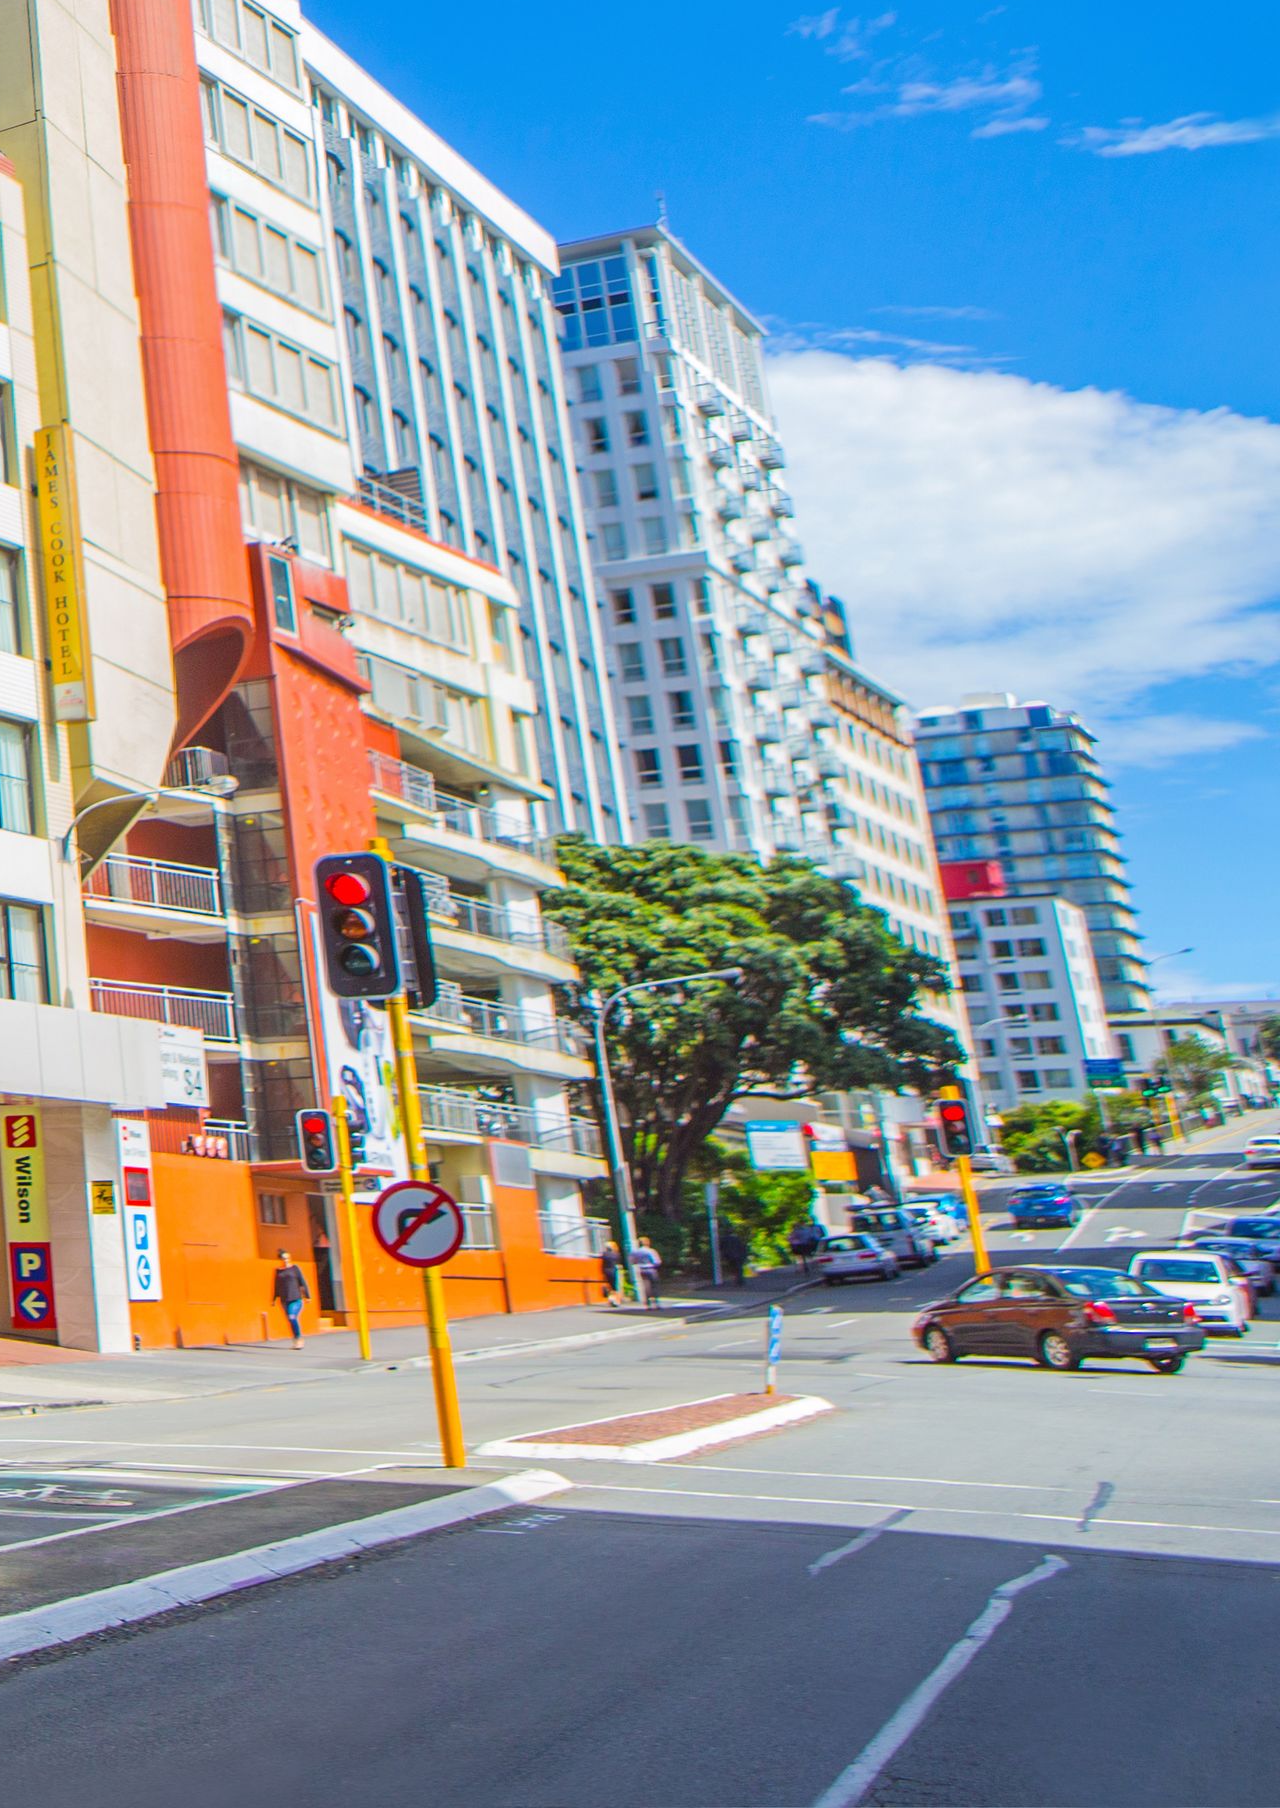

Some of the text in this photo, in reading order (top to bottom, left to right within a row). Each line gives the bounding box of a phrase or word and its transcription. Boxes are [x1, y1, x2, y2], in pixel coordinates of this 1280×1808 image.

[44, 433, 59, 509] JAMES
[50, 522, 66, 584] COOK
[55, 596, 73, 675] HOTEL
[15, 1155, 32, 1224] Wilson
[19, 1252, 41, 1277] P
